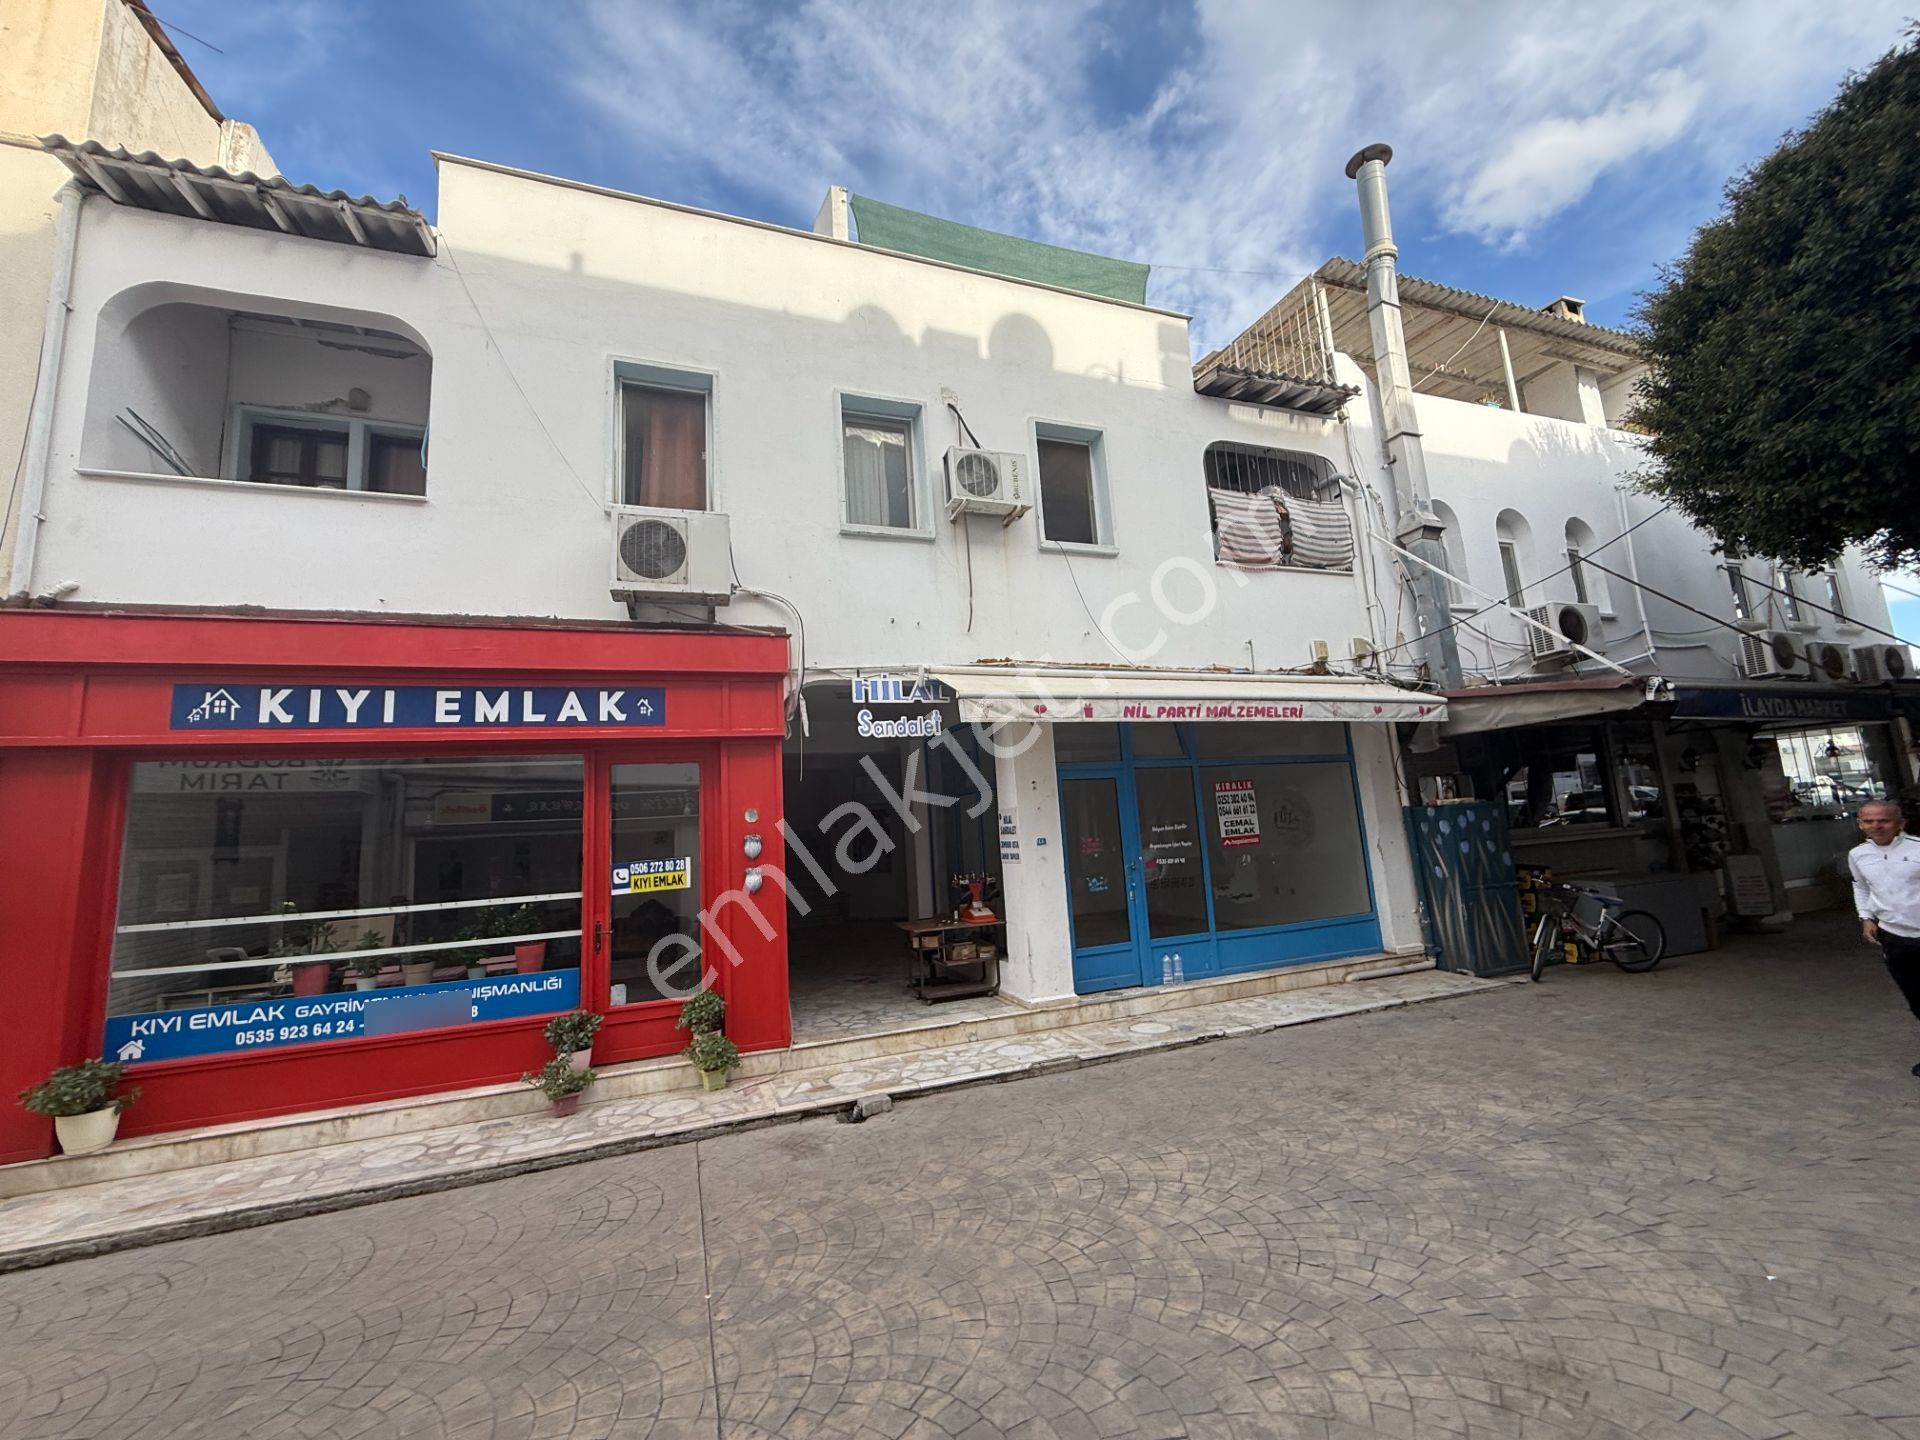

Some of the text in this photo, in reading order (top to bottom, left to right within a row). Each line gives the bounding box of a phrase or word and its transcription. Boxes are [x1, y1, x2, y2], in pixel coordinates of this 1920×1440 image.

[258, 688, 628, 724] KIYI EMLAK
[1123, 702, 1303, 719] NİL PARTİ MALZEMELERİ
[1739, 692, 1849, 718] İLAYDA MARKET
[857, 709, 942, 738] Sandalet
[1224, 819, 1255, 828] CEMAL
[1225, 827, 1256, 836] EMLAK
[630, 859, 685, 875] 0506 272 80 28
[633, 873, 684, 890] KIYI EMLAK
[131, 1015, 182, 1037] KIYI
[189, 1004, 285, 1030] EMLAK
[235, 1028, 275, 1046] 0535
[280, 1024, 308, 1040] 923
[312, 1022, 331, 1036] 64
[336, 1019, 354, 1033] 24
